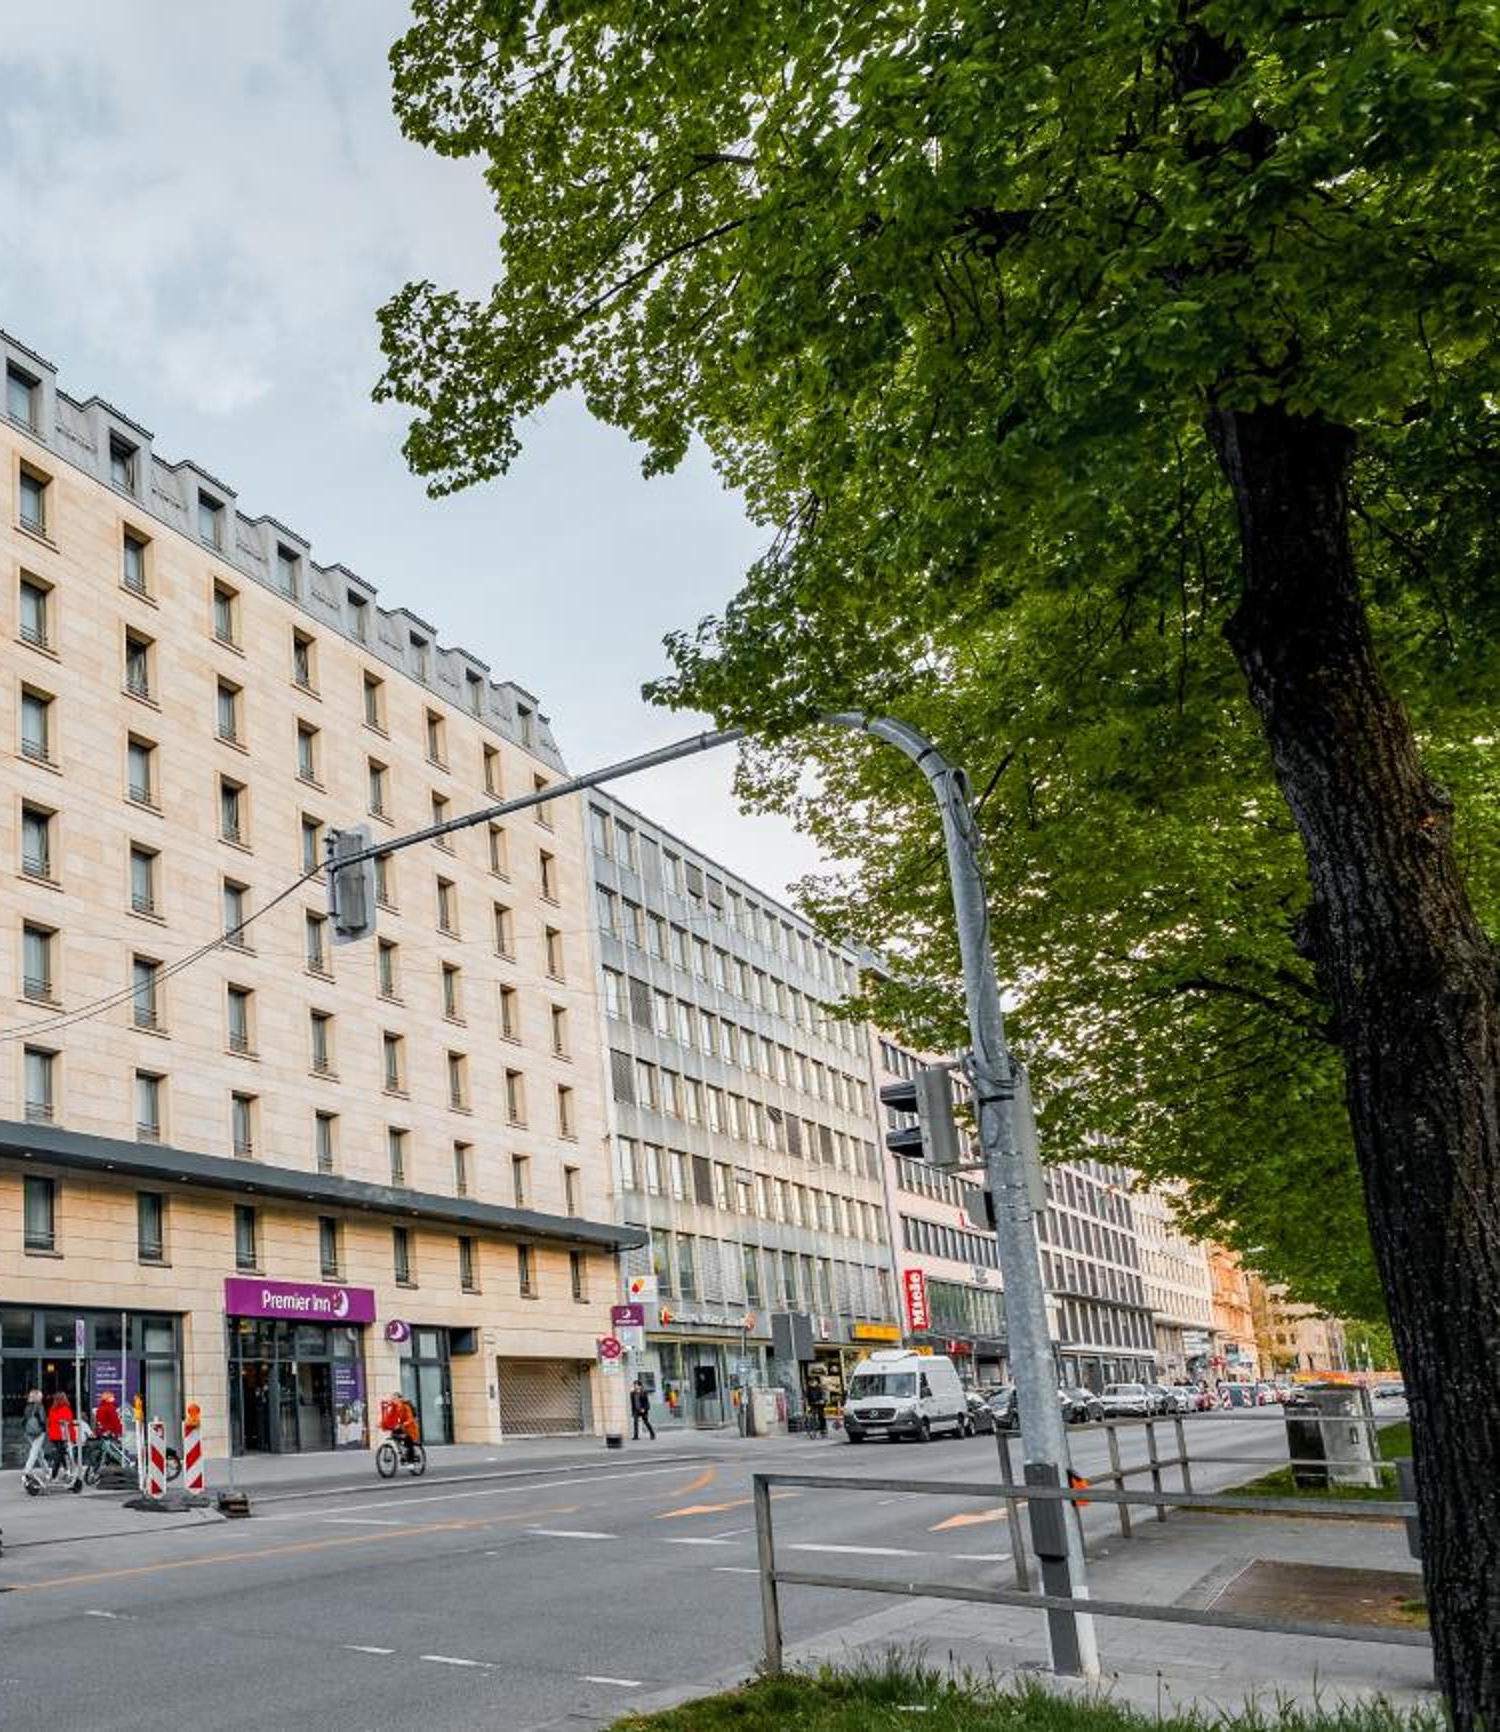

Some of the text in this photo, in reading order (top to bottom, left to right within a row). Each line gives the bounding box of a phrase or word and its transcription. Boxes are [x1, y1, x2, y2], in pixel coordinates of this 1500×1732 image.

[262, 1289, 331, 1313] Premier Inn
[908, 1272, 927, 1326] Miele
